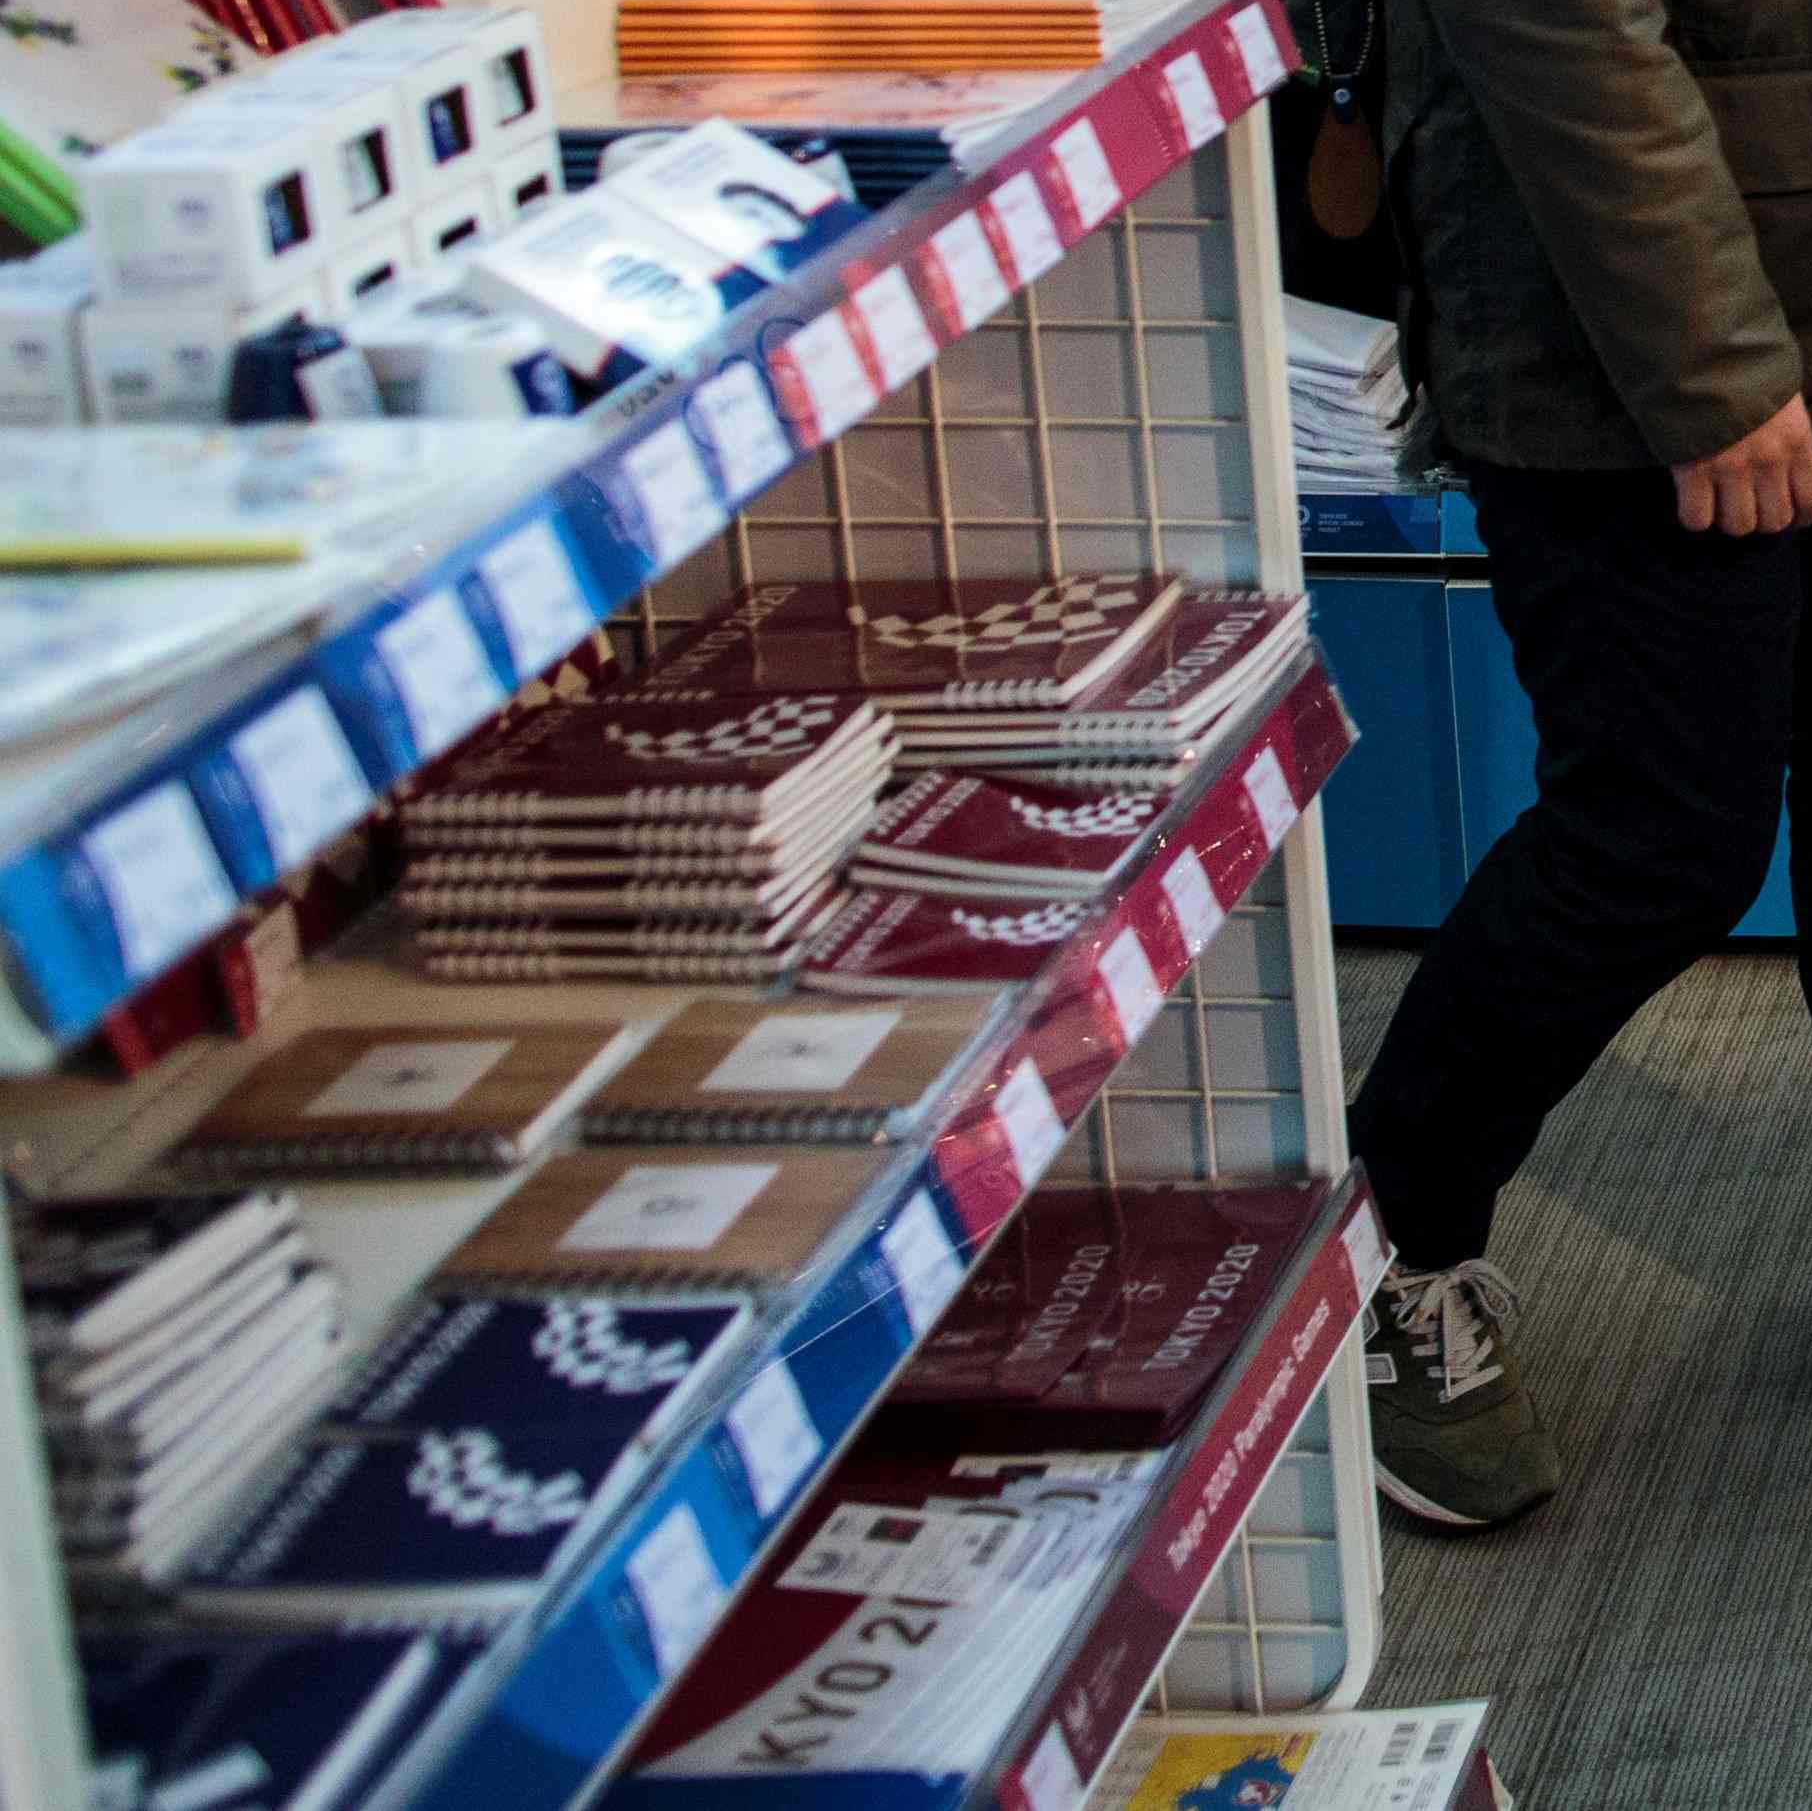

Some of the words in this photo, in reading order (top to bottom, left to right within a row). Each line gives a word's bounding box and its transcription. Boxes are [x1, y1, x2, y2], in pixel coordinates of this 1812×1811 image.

[1059, 1244, 1112, 1297] 2020
[1142, 1305, 1221, 1372] TOKYO
[1202, 1243, 1260, 1302] 2020
[1168, 1508, 1208, 1573] Tokyo
[1203, 1450, 1240, 1516] 2020
[1234, 1355, 1298, 1460] Paralympic
[1292, 1297, 1330, 1363] Games
[735, 1662, 894, 1767] KYO
